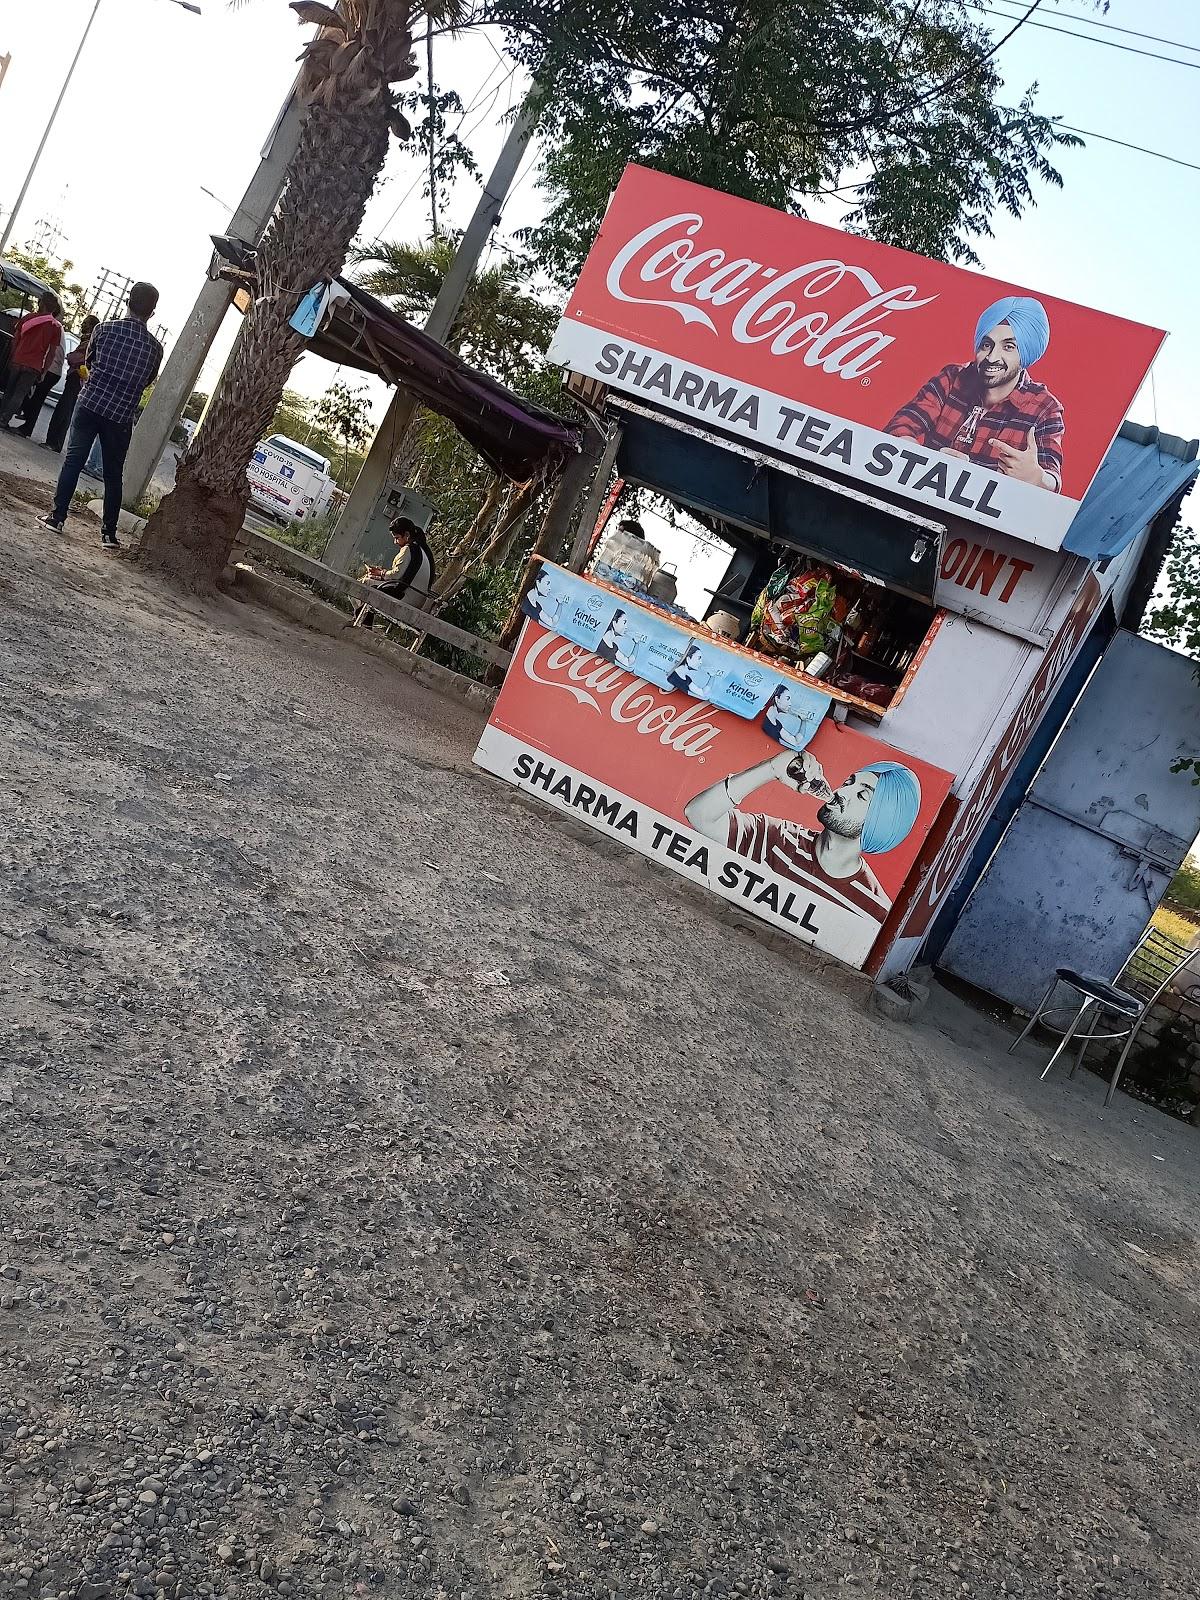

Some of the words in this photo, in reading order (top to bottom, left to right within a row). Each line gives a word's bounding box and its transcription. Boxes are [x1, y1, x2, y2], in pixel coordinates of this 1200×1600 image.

[606, 212, 941, 380] Coca-Cola
[595, 343, 760, 431] SHARMA
[776, 404, 854, 466] TEA
[864, 441, 1002, 519] STALL
[260, 468, 289, 489] HOSPITAL
[263, 448, 293, 468] COVID-19
[940, 538, 1035, 604] OINT
[574, 607, 602, 628] kinley
[728, 681, 760, 702] kinley
[512, 753, 639, 839] SHARMA
[651, 818, 709, 877] TEA
[717, 860, 820, 935] STALL
